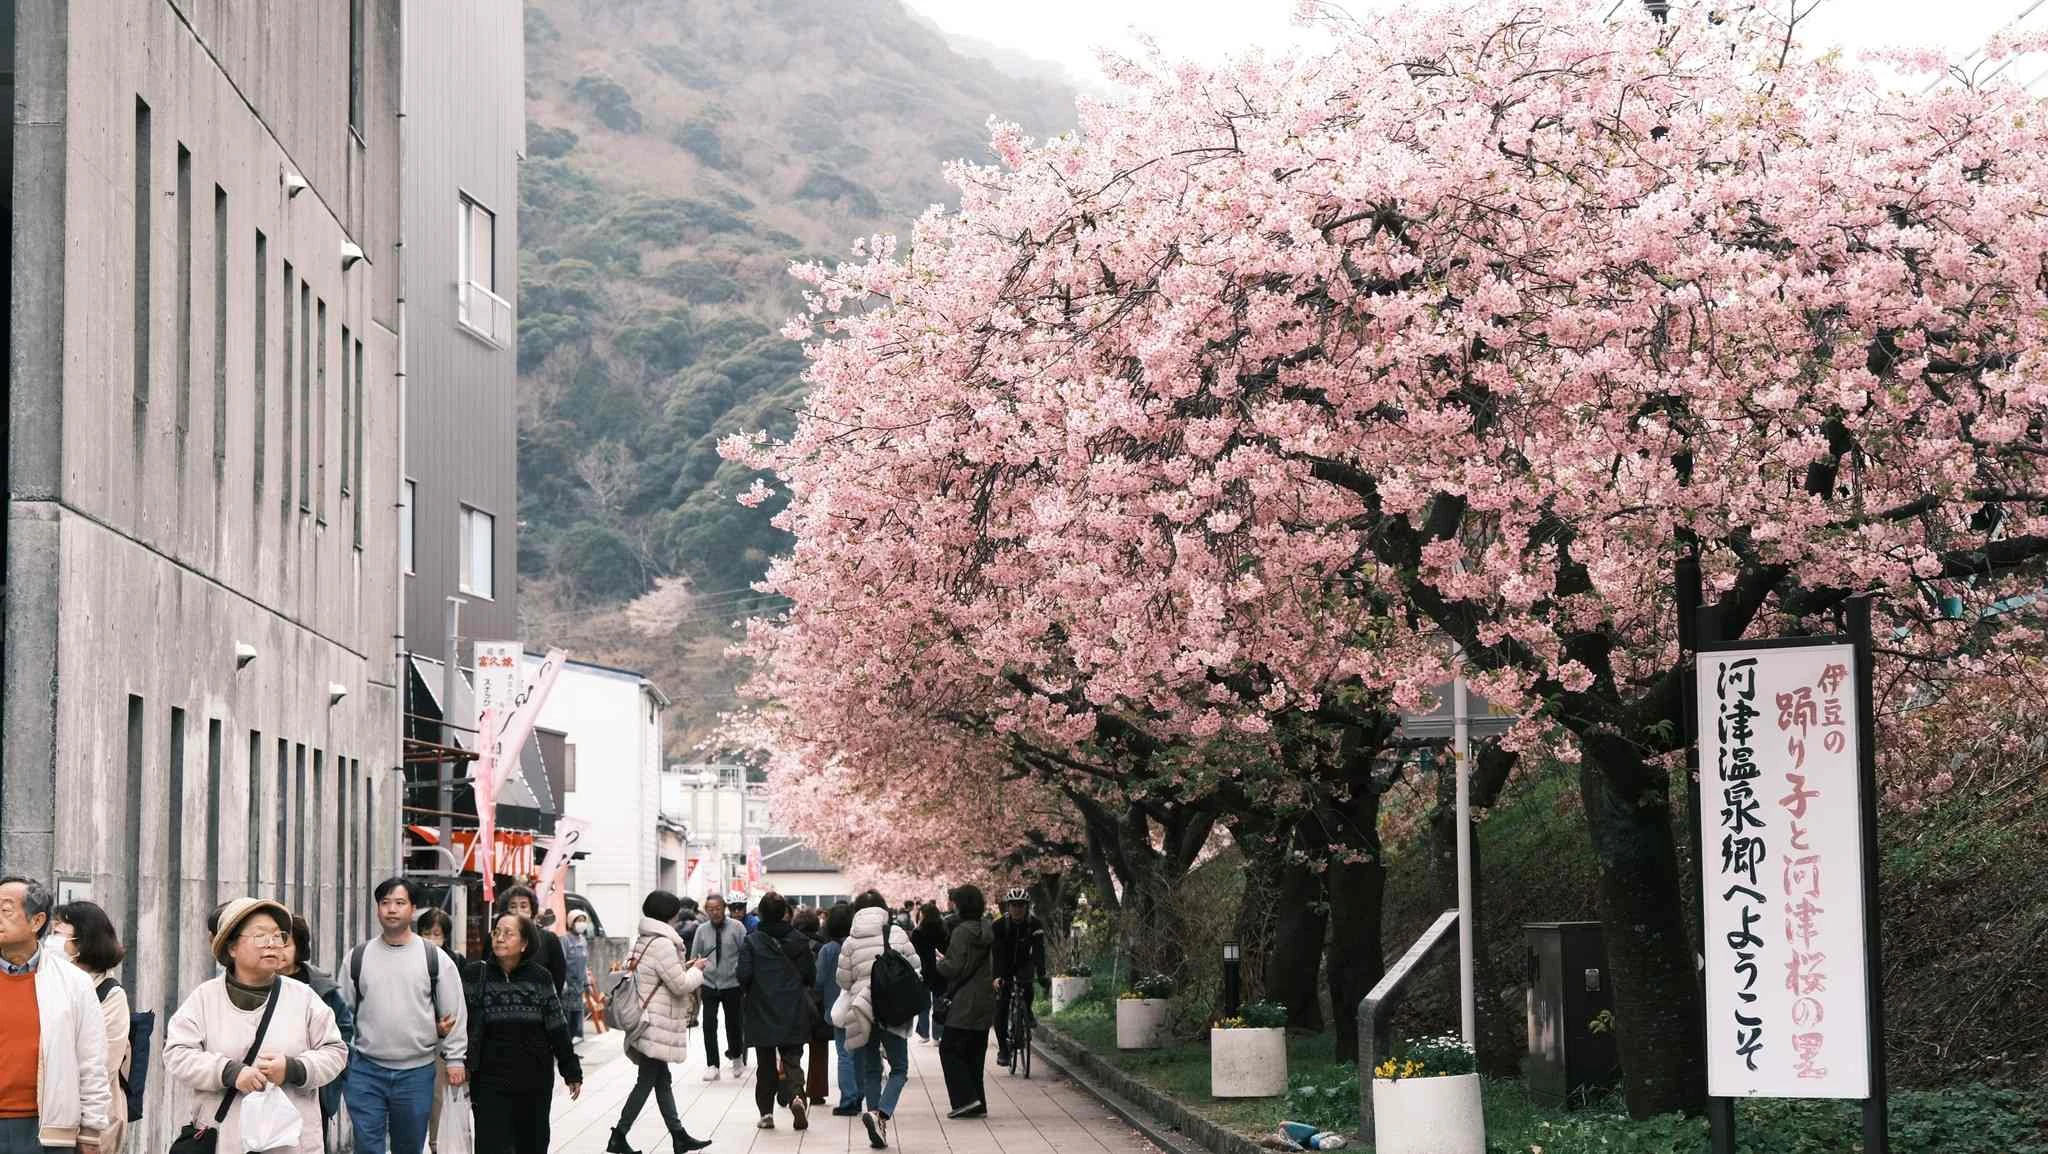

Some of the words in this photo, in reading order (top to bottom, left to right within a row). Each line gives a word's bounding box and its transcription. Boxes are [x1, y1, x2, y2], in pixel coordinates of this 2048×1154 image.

[1717, 658, 1767, 1070] 河津温泉郷へようこそ
[1776, 688, 1827, 1079] 踊り子と河津桜の里
[1817, 664, 1848, 752] 伊豆の
